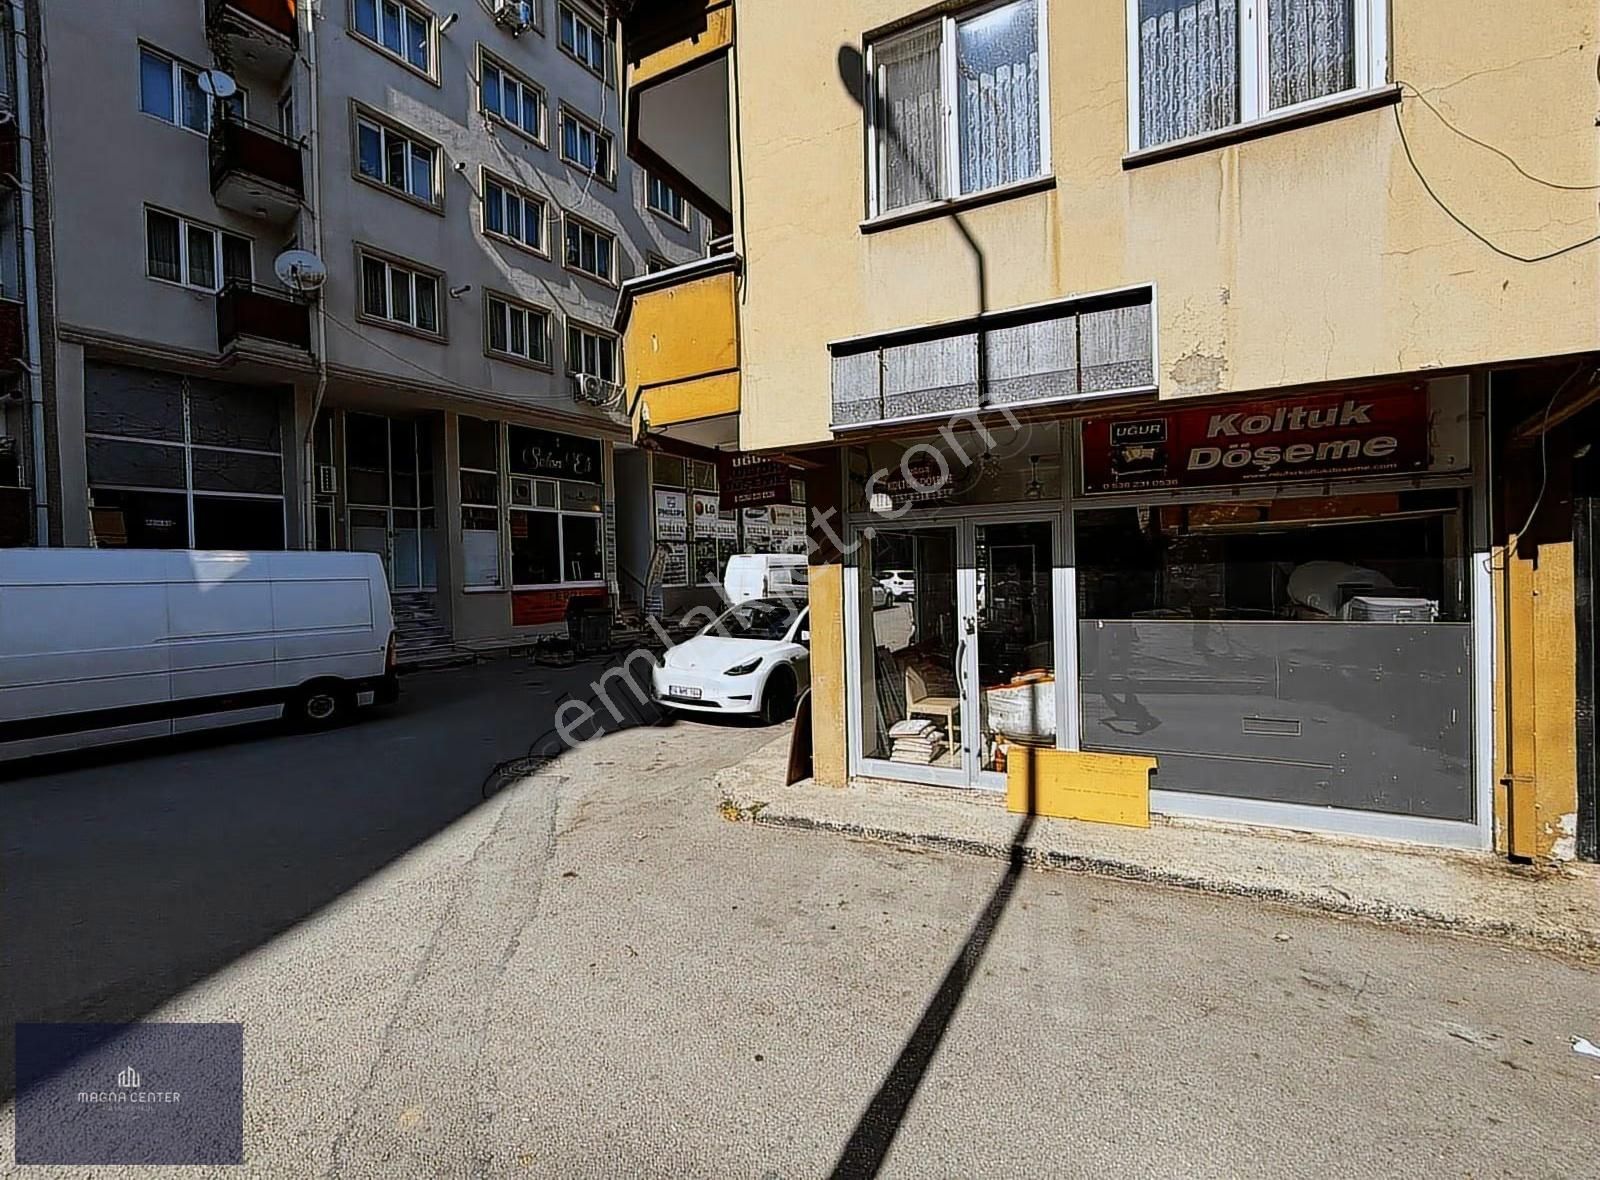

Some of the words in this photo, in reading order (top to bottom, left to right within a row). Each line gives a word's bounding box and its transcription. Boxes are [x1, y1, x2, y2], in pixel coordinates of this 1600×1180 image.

[1207, 400, 1375, 438] Koltuk
[1187, 435, 1398, 472] Döşeme
[704, 503, 716, 515] LG
